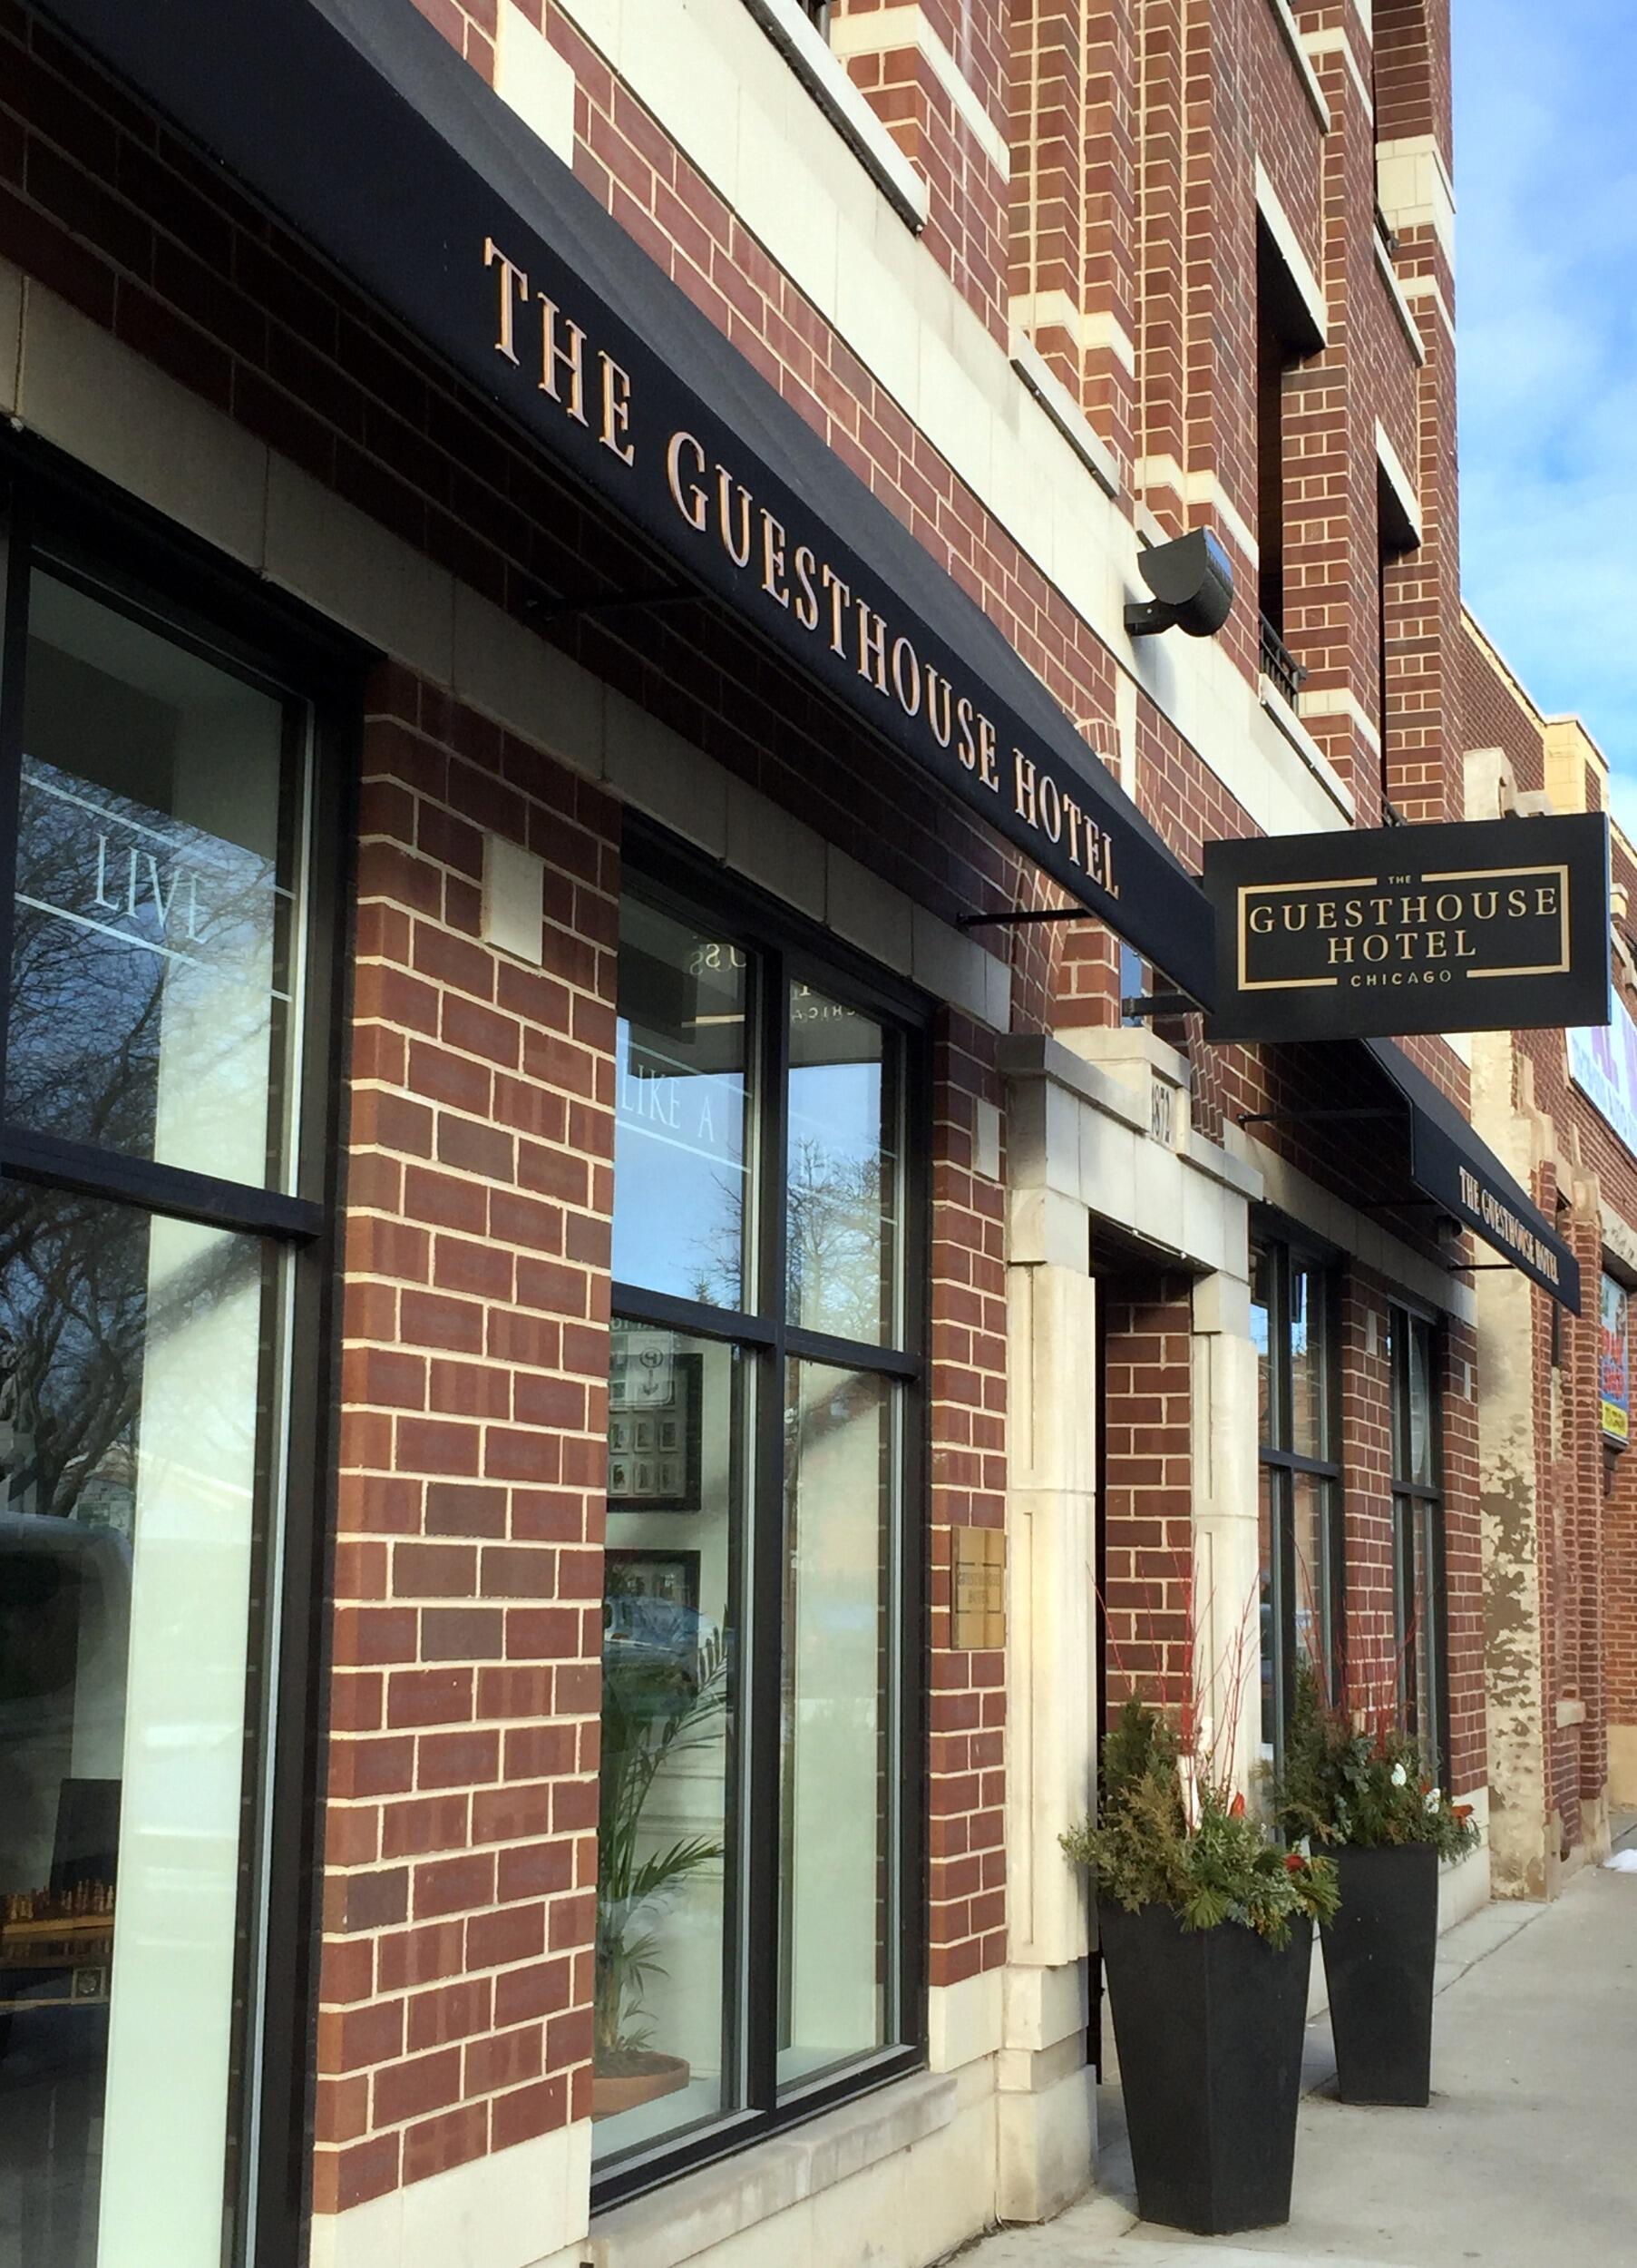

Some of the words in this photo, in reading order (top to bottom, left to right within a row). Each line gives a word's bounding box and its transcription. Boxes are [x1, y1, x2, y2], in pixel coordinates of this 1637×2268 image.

[484, 237, 635, 467] THE
[667, 431, 999, 795] GUESTHOUSE
[1012, 748, 1119, 900] HOTEL
[1388, 875, 1412, 885] THE
[1249, 887, 1558, 934] GUESTHOUSE
[1327, 929, 1476, 964] HOTEL
[1350, 969, 1452, 988] CHICAGO
[621, 1059, 681, 1129] LIKE
[697, 1095, 715, 1142] A
[1459, 1165, 1481, 1217] THE
